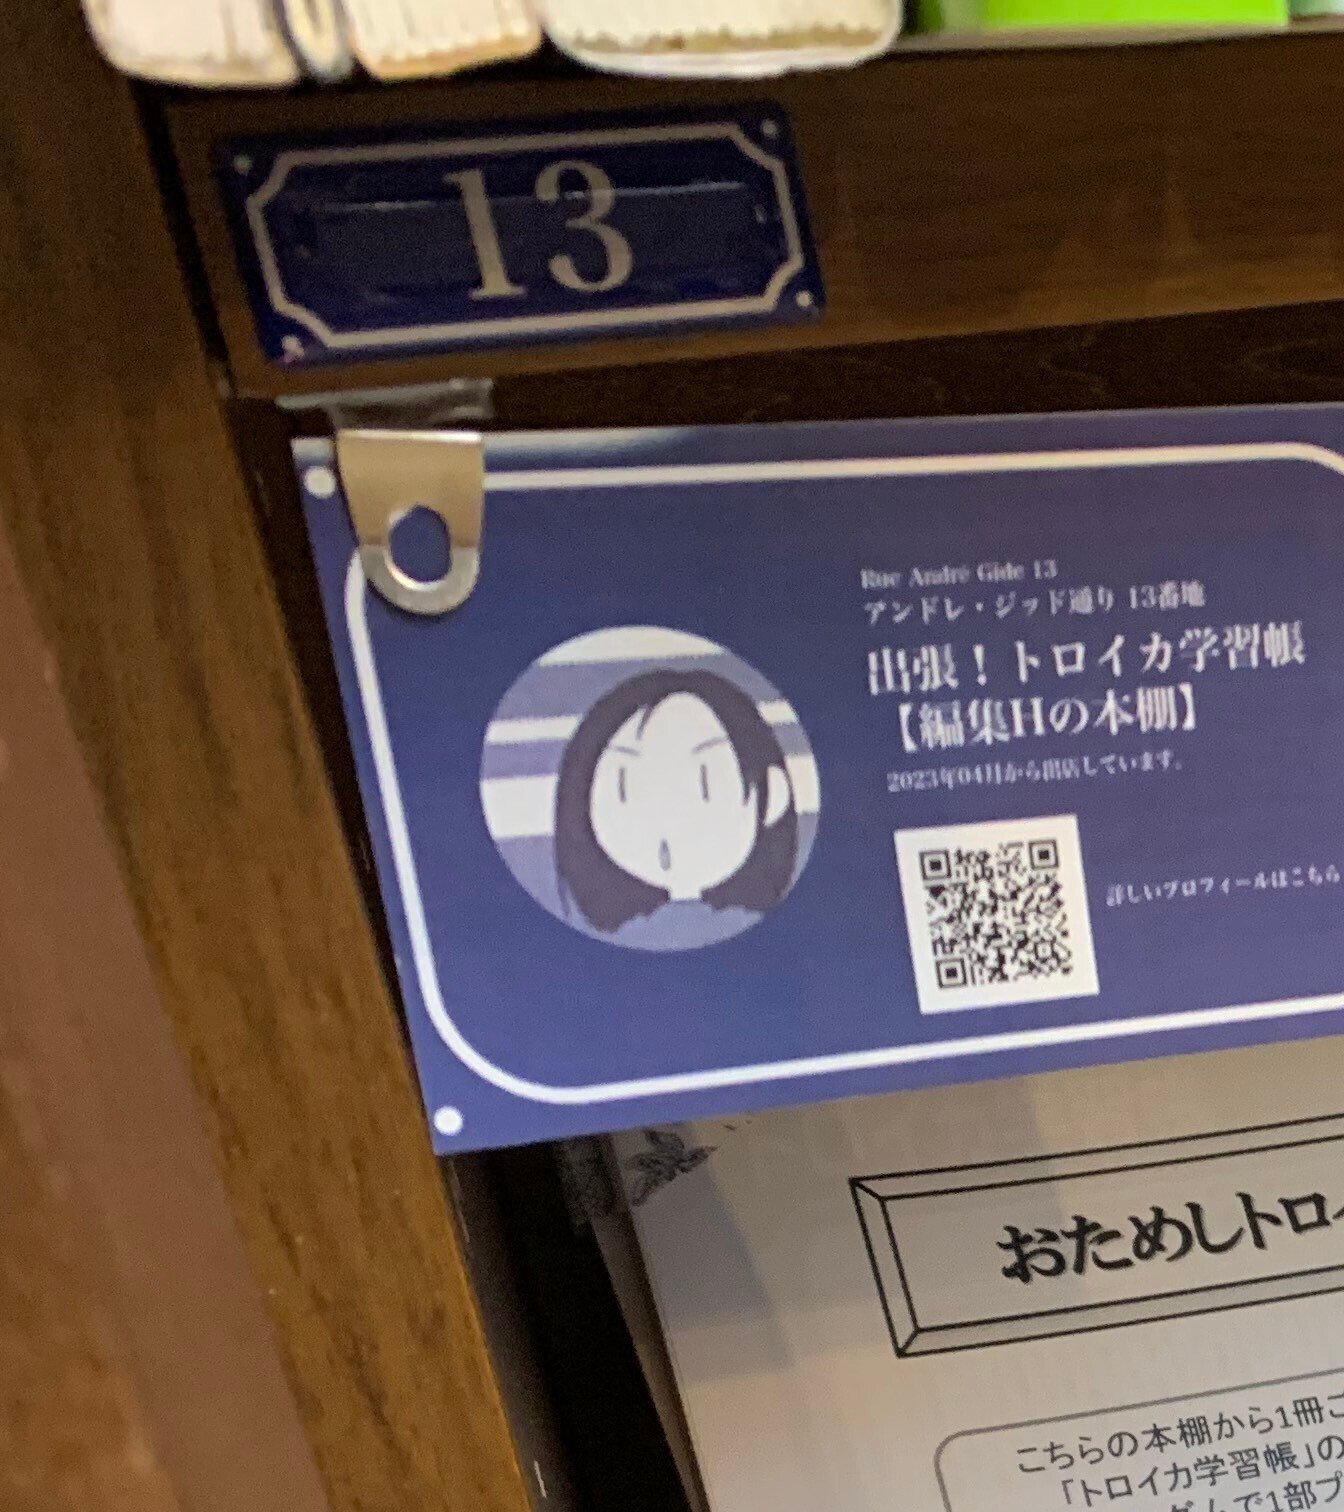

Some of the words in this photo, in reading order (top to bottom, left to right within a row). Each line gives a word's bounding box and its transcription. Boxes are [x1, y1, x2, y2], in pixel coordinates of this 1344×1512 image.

[443, 160, 633, 301] 13
[1033, 559, 1057, 580] 13
[1127, 580, 1206, 610] 13番地
